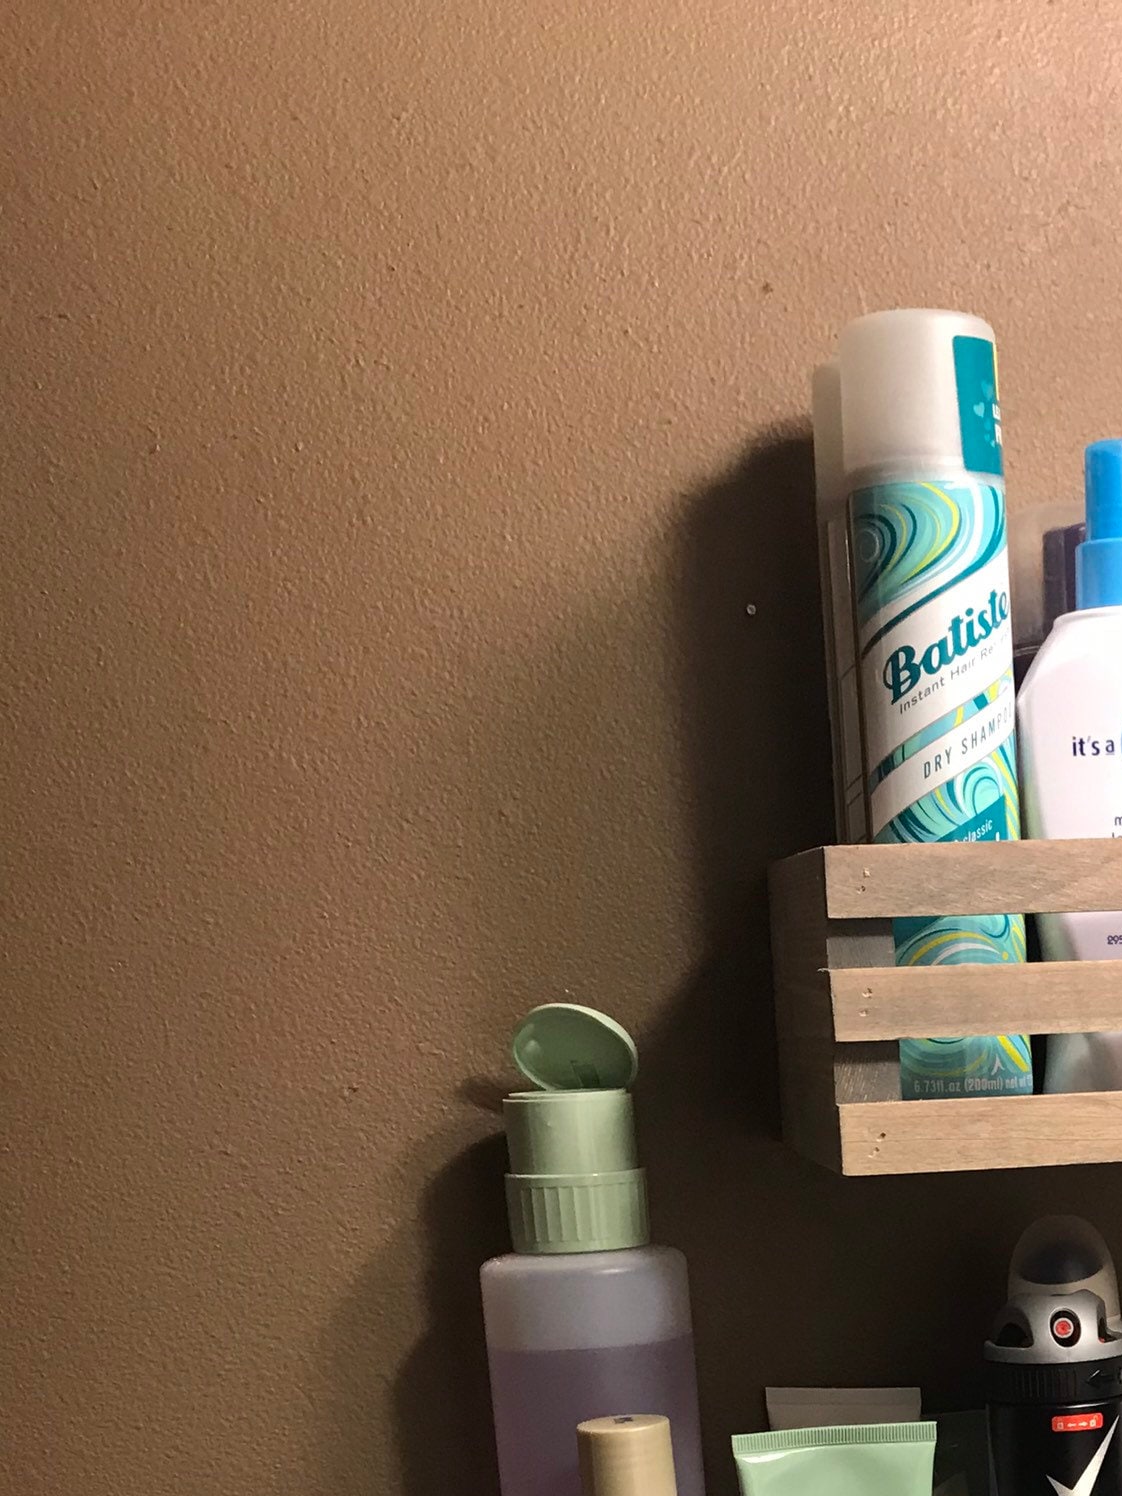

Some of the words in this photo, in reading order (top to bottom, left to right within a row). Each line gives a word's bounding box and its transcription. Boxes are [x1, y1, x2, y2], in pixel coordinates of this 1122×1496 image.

[883, 589, 1009, 705] Batiste
[899, 676, 945, 715] Instant
[923, 746, 953, 780] DRY
[1072, 736, 1101, 757] it's
[1105, 739, 1116, 756] a
